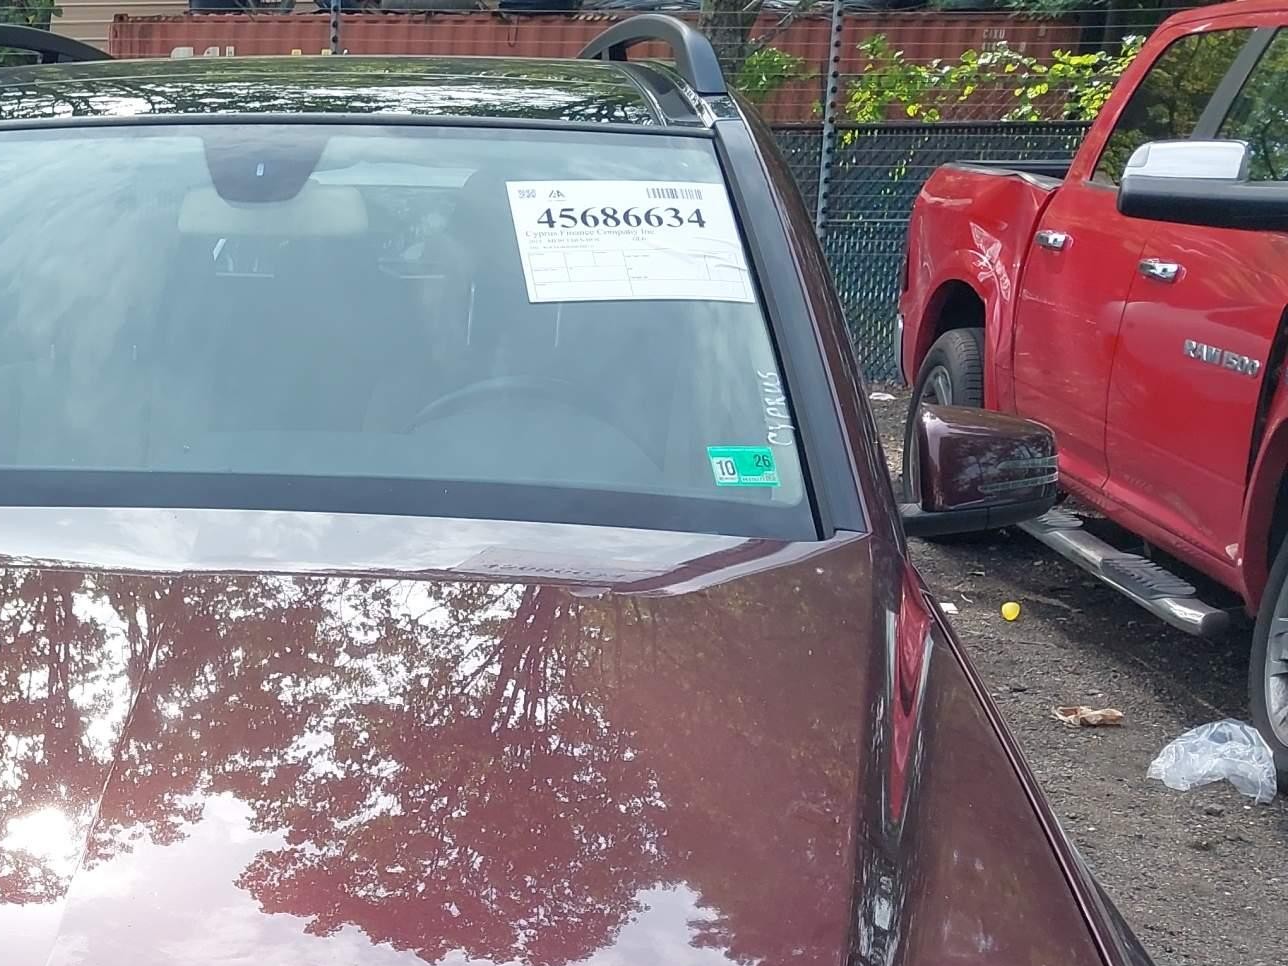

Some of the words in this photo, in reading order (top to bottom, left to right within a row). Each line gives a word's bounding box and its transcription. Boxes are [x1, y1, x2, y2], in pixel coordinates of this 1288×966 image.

[537, 206, 706, 228] 45686634
[1183, 339, 1223, 366] RAM
[1223, 350, 1259, 377] 1500
[717, 460, 736, 476] 10
[754, 454, 771, 468] 26
